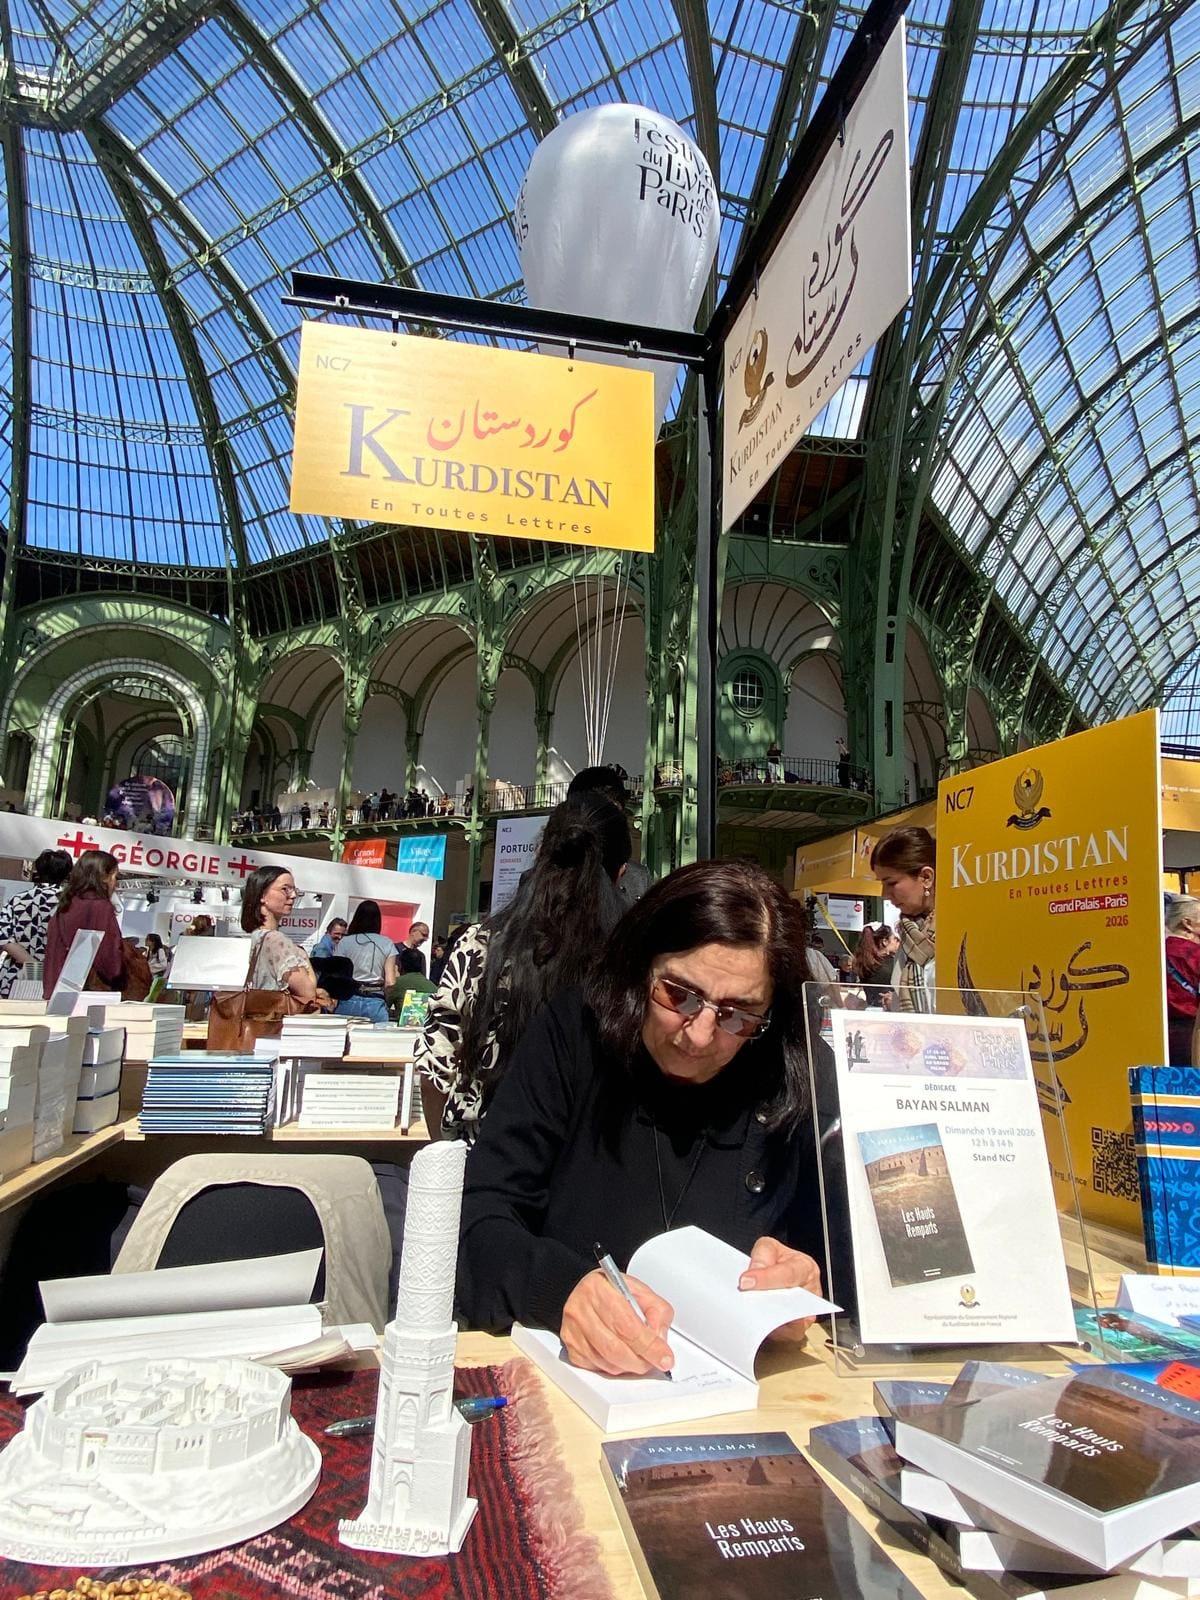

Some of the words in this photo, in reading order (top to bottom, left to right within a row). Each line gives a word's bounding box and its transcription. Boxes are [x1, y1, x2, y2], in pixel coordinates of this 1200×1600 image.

[643, 148, 662, 167] du
[316, 355, 351, 371] NC7
[749, 469, 759, 489] En
[765, 414, 801, 465] Toutes
[809, 333, 862, 409] Lettres
[371, 499, 393, 512] En
[412, 503, 488, 522] Toutes
[507, 513, 593, 534] Lettres
[945, 787, 974, 813] NC7
[109, 840, 220, 875] GÉORGIE
[951, 826, 1129, 889] KURDISTAN
[1009, 888, 1022, 899] En
[1028, 883, 1069, 897] Toutes
[1075, 875, 1128, 891] Lettres
[1049, 901, 1075, 913] Grand
[1074, 898, 1100, 911] Palais
[1105, 894, 1128, 908] Paris
[281, 917, 317, 928] BILISSI
[1105, 915, 1129, 928] 2026
[896, 1098, 938, 1111] BAYAN
[940, 1100, 990, 1113] SALMAN
[945, 1126, 985, 1136] Dimanche
[987, 1127, 997, 1136] 19
[998, 1128, 1015, 1136] avril
[1016, 1128, 1036, 1137] 2026
[972, 1153, 997, 1162] Stand
[999, 1154, 1016, 1162] NC7
[901, 1208, 915, 1223] Les
[914, 1206, 936, 1221] Hauts
[905, 1222, 939, 1239] Remparts
[1018, 1420, 1101, 1457] Remparts
[1037, 1413, 1072, 1430] Les
[1069, 1426, 1124, 1452] Hauts
[648, 1446, 693, 1454] BAYAN
[700, 1443, 757, 1452] SALMAN
[705, 1521, 740, 1540] Les
[740, 1517, 794, 1536] Hauts
[717, 1535, 805, 1559] Remparts
